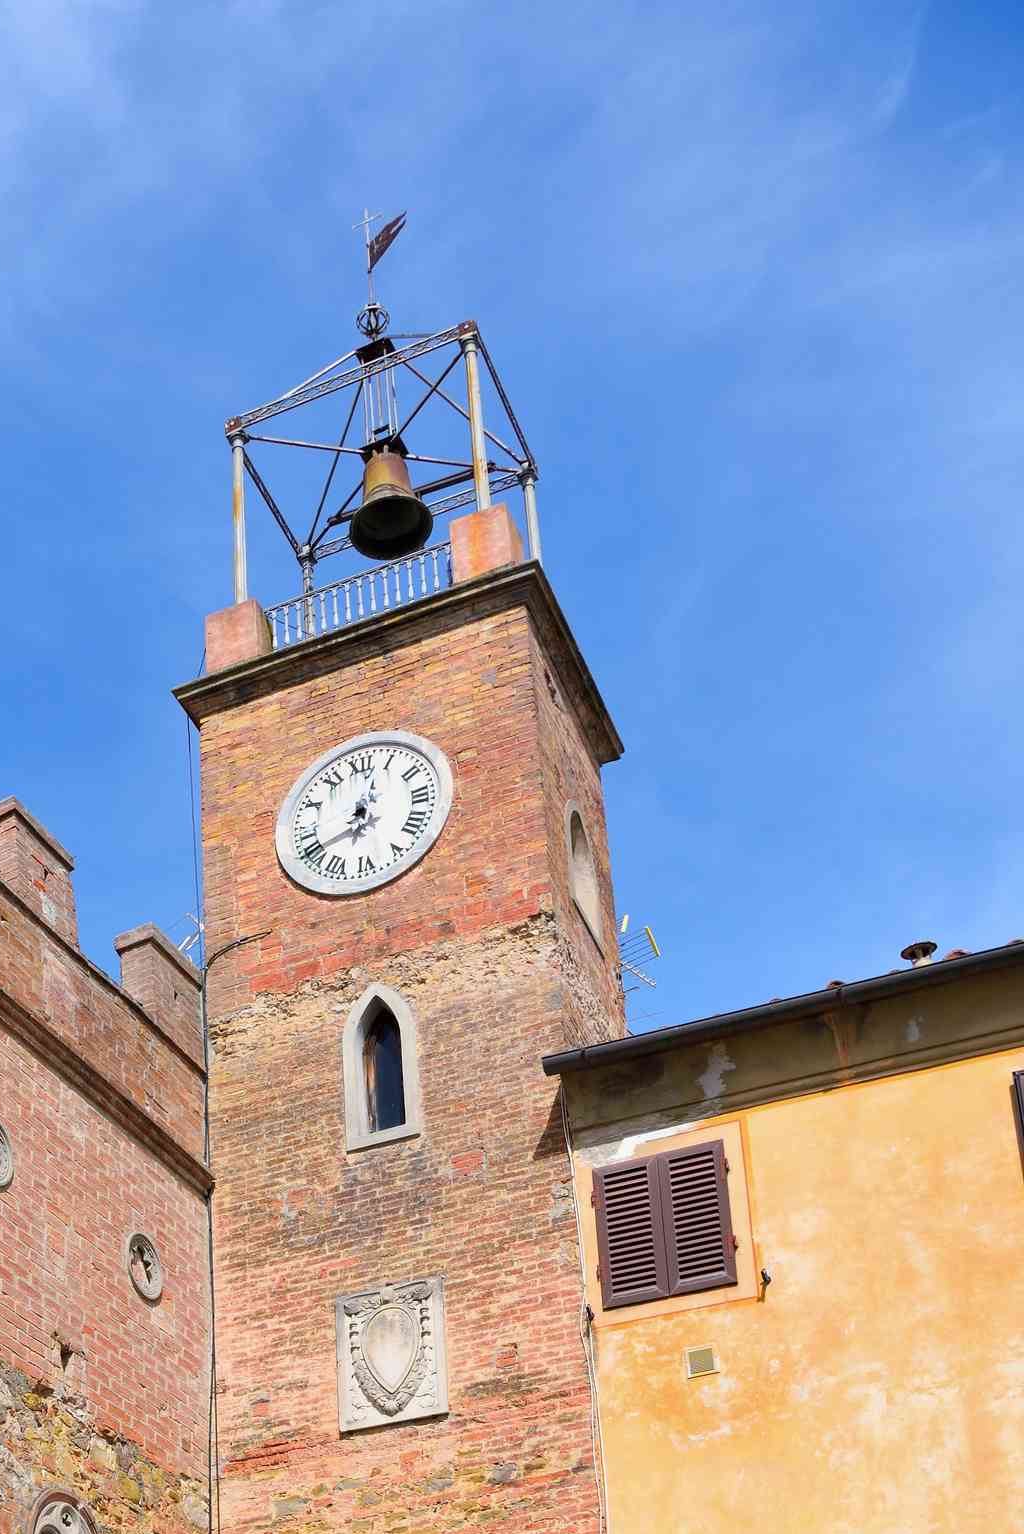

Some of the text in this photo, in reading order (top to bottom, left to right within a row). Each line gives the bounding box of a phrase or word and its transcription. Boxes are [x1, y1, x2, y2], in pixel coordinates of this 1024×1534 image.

[384, 755, 394, 769] I
[401, 765, 420, 782] II
[411, 785, 429, 804] III
[390, 843, 404, 857] V
[358, 856, 375, 873] VI
